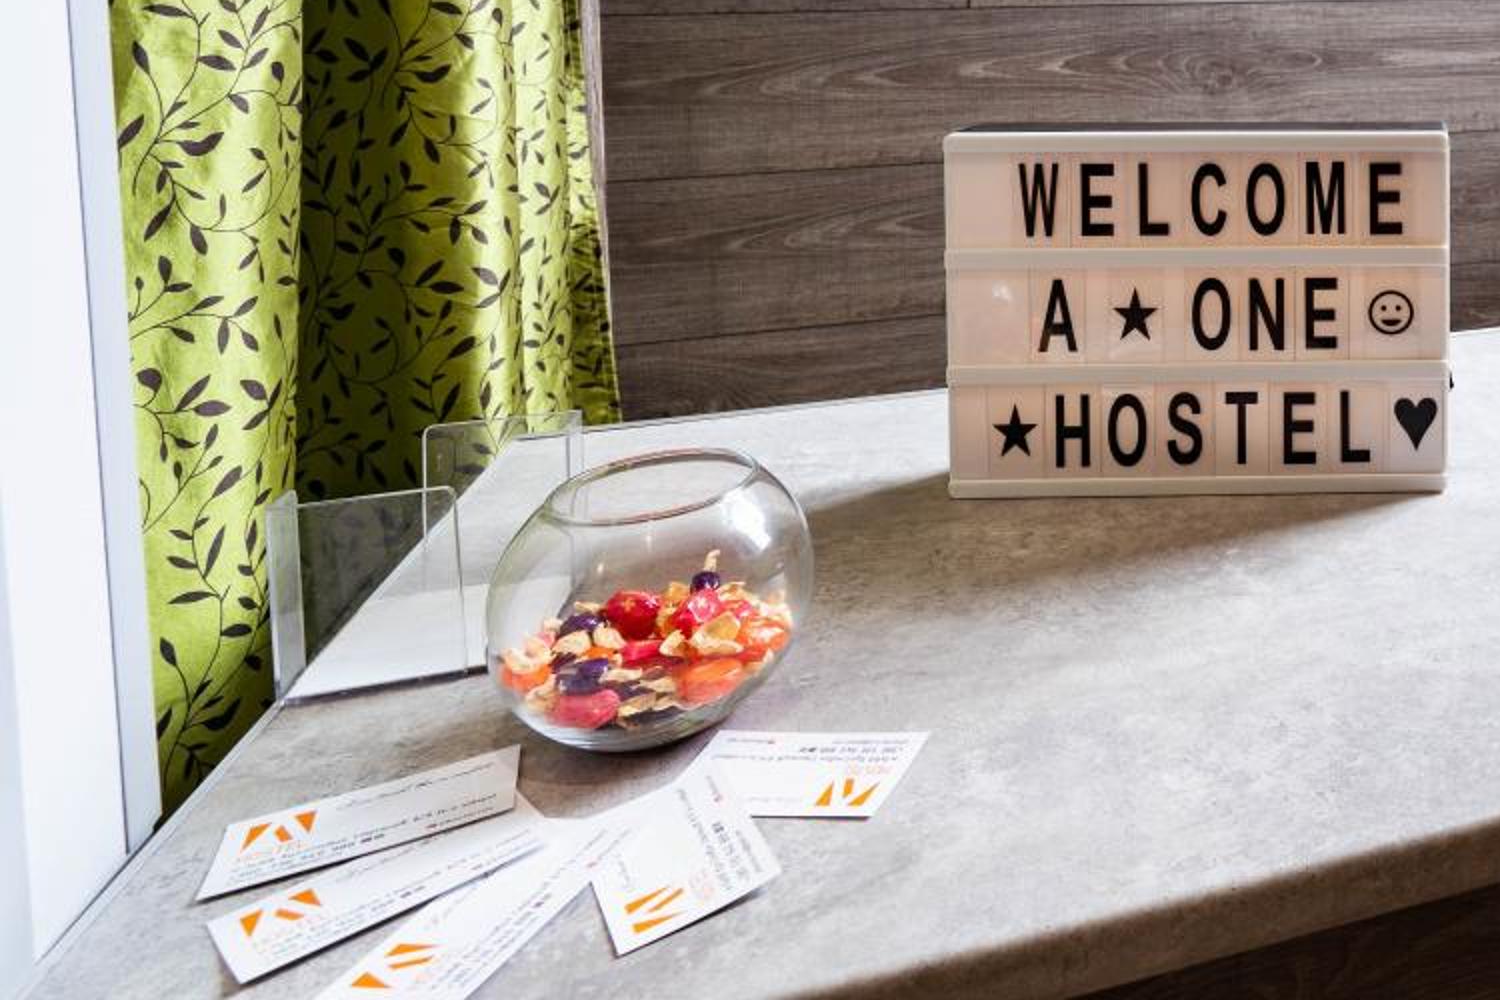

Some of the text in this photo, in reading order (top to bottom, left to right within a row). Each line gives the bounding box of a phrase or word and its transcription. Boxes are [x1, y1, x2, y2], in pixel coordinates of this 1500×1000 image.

[1018, 160, 1404, 238] WELCOME
[1037, 276, 1339, 353] A ONE
[1054, 389, 1372, 469] HOSTEL
